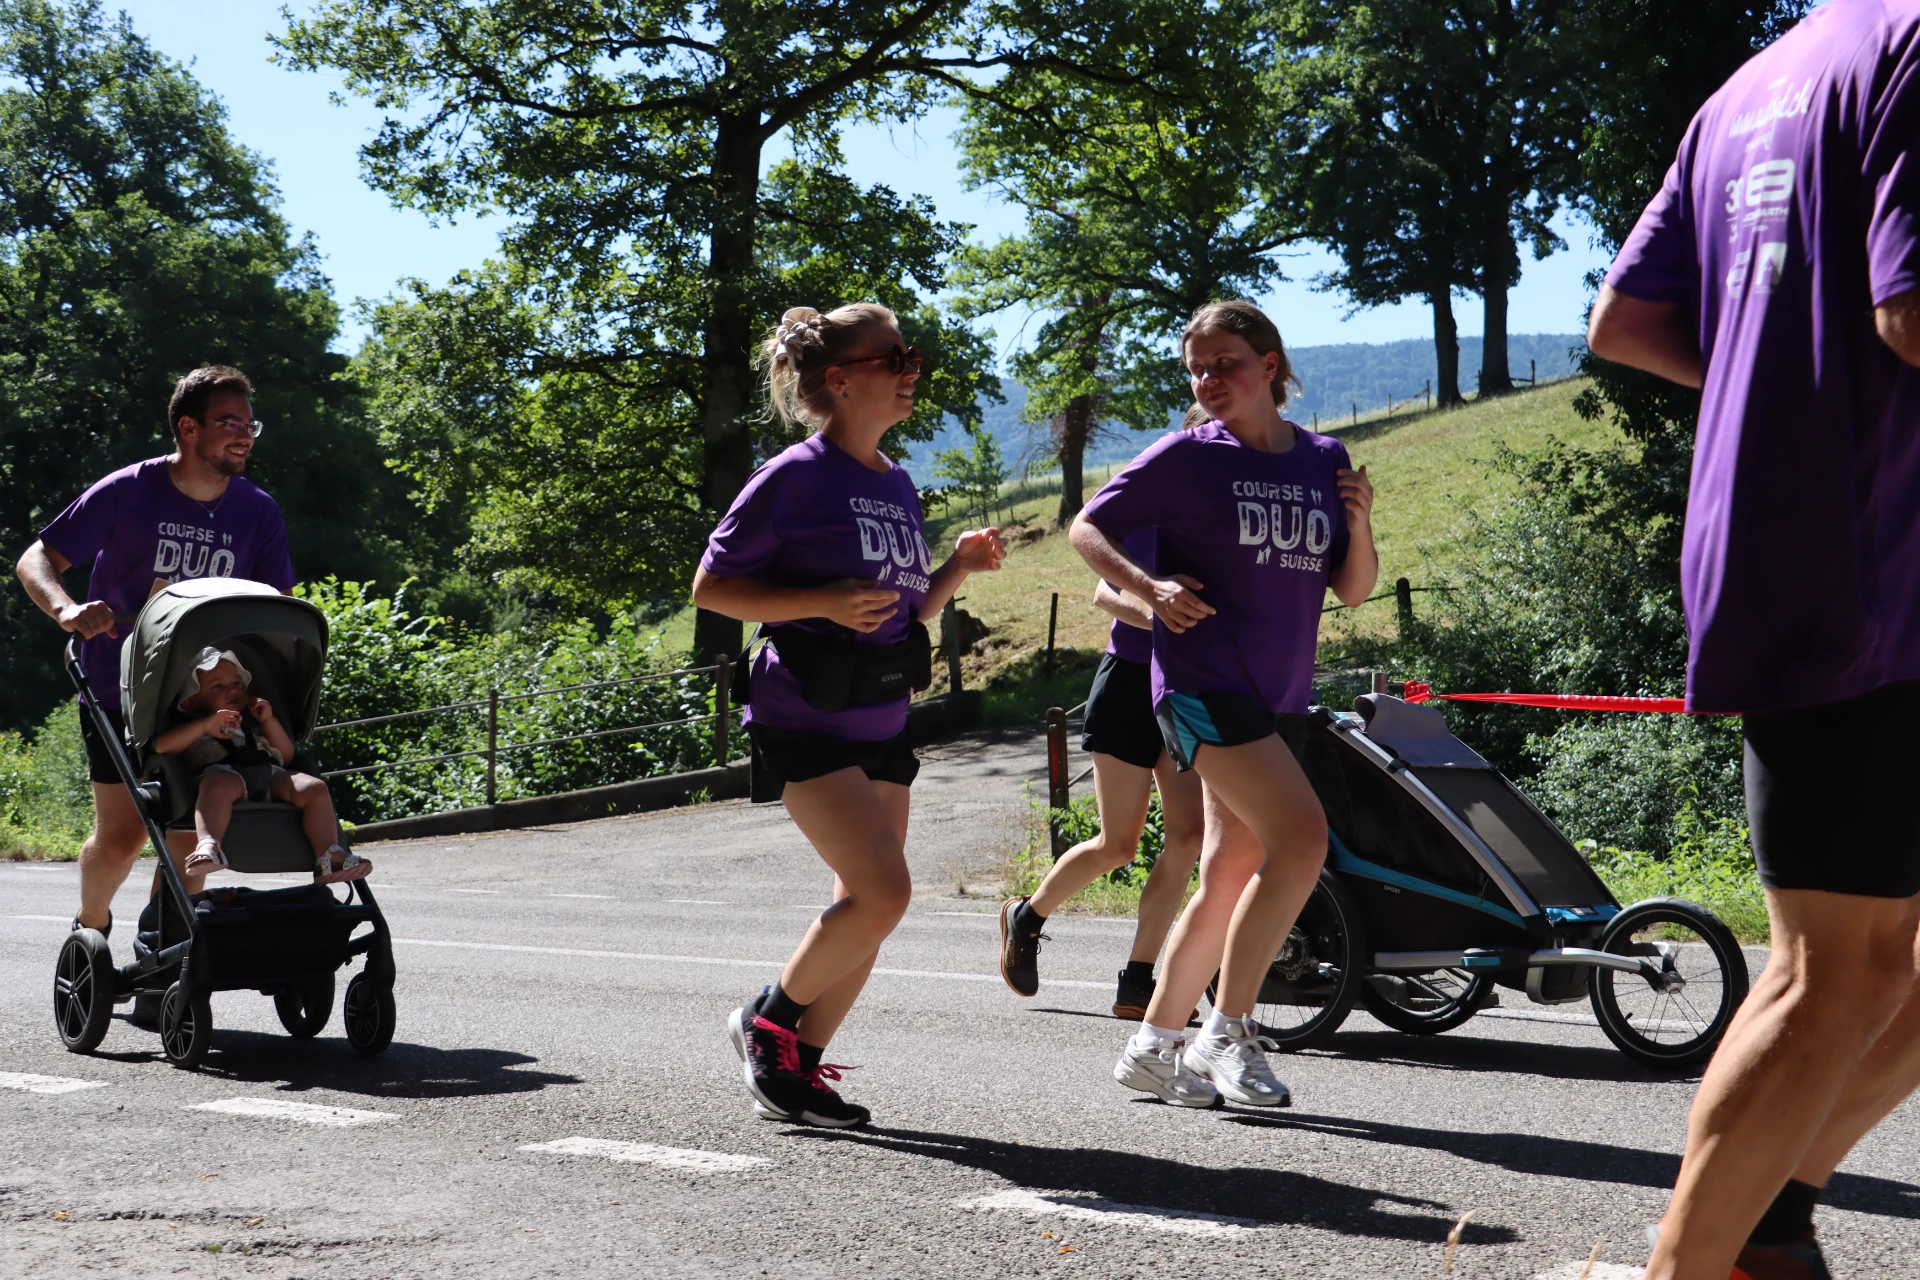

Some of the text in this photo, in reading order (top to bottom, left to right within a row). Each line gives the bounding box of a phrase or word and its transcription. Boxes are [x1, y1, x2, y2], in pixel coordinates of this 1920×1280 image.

[1232, 481, 1304, 501] COURSE
[849, 497, 908, 522] COURSE
[158, 522, 215, 543] COURSE
[1237, 501, 1331, 555] DUO
[153, 539, 235, 578] DUO
[1279, 553, 1324, 573] SUISSE
[895, 571, 930, 593] SUISSE
